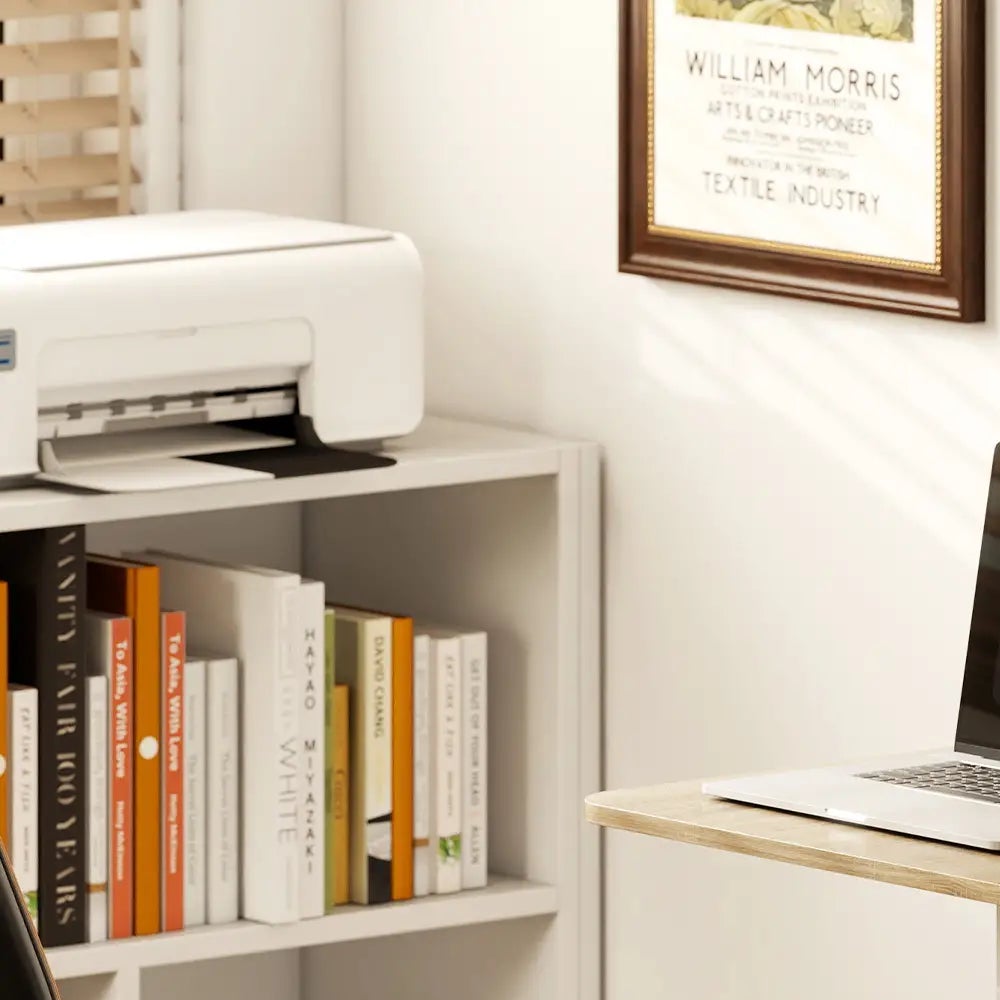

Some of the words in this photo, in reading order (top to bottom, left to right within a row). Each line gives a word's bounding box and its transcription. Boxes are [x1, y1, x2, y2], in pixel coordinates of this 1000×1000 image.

[686, 50, 787, 86] WILLIAM
[805, 64, 901, 101] MORRIS
[707, 101, 741, 121] ARTS
[758, 106, 812, 128] CRAFTS
[815, 113, 874, 135] PIONEER
[702, 170, 775, 202] TEXTILE
[788, 183, 880, 216] INDUSTRY
[57, 531, 76, 642] VANITY
[114, 640, 128, 659] To
[168, 633, 181, 653] To
[373, 636, 384, 681] DAVID
[114, 664, 128, 699] Asia,
[168, 656, 182, 694] Asia,
[304, 628, 316, 710] HAYAO
[57, 662, 76, 736] FAIR
[114, 703, 128, 740] With
[168, 696, 182, 733] With
[373, 686, 384, 739] CHANG
[114, 744, 128, 778] Love
[168, 736, 181, 771] Love
[279, 736, 297, 845] WHITE
[304, 739, 316, 875] MIYAZAKI
[56, 816, 76, 925] YEARS
